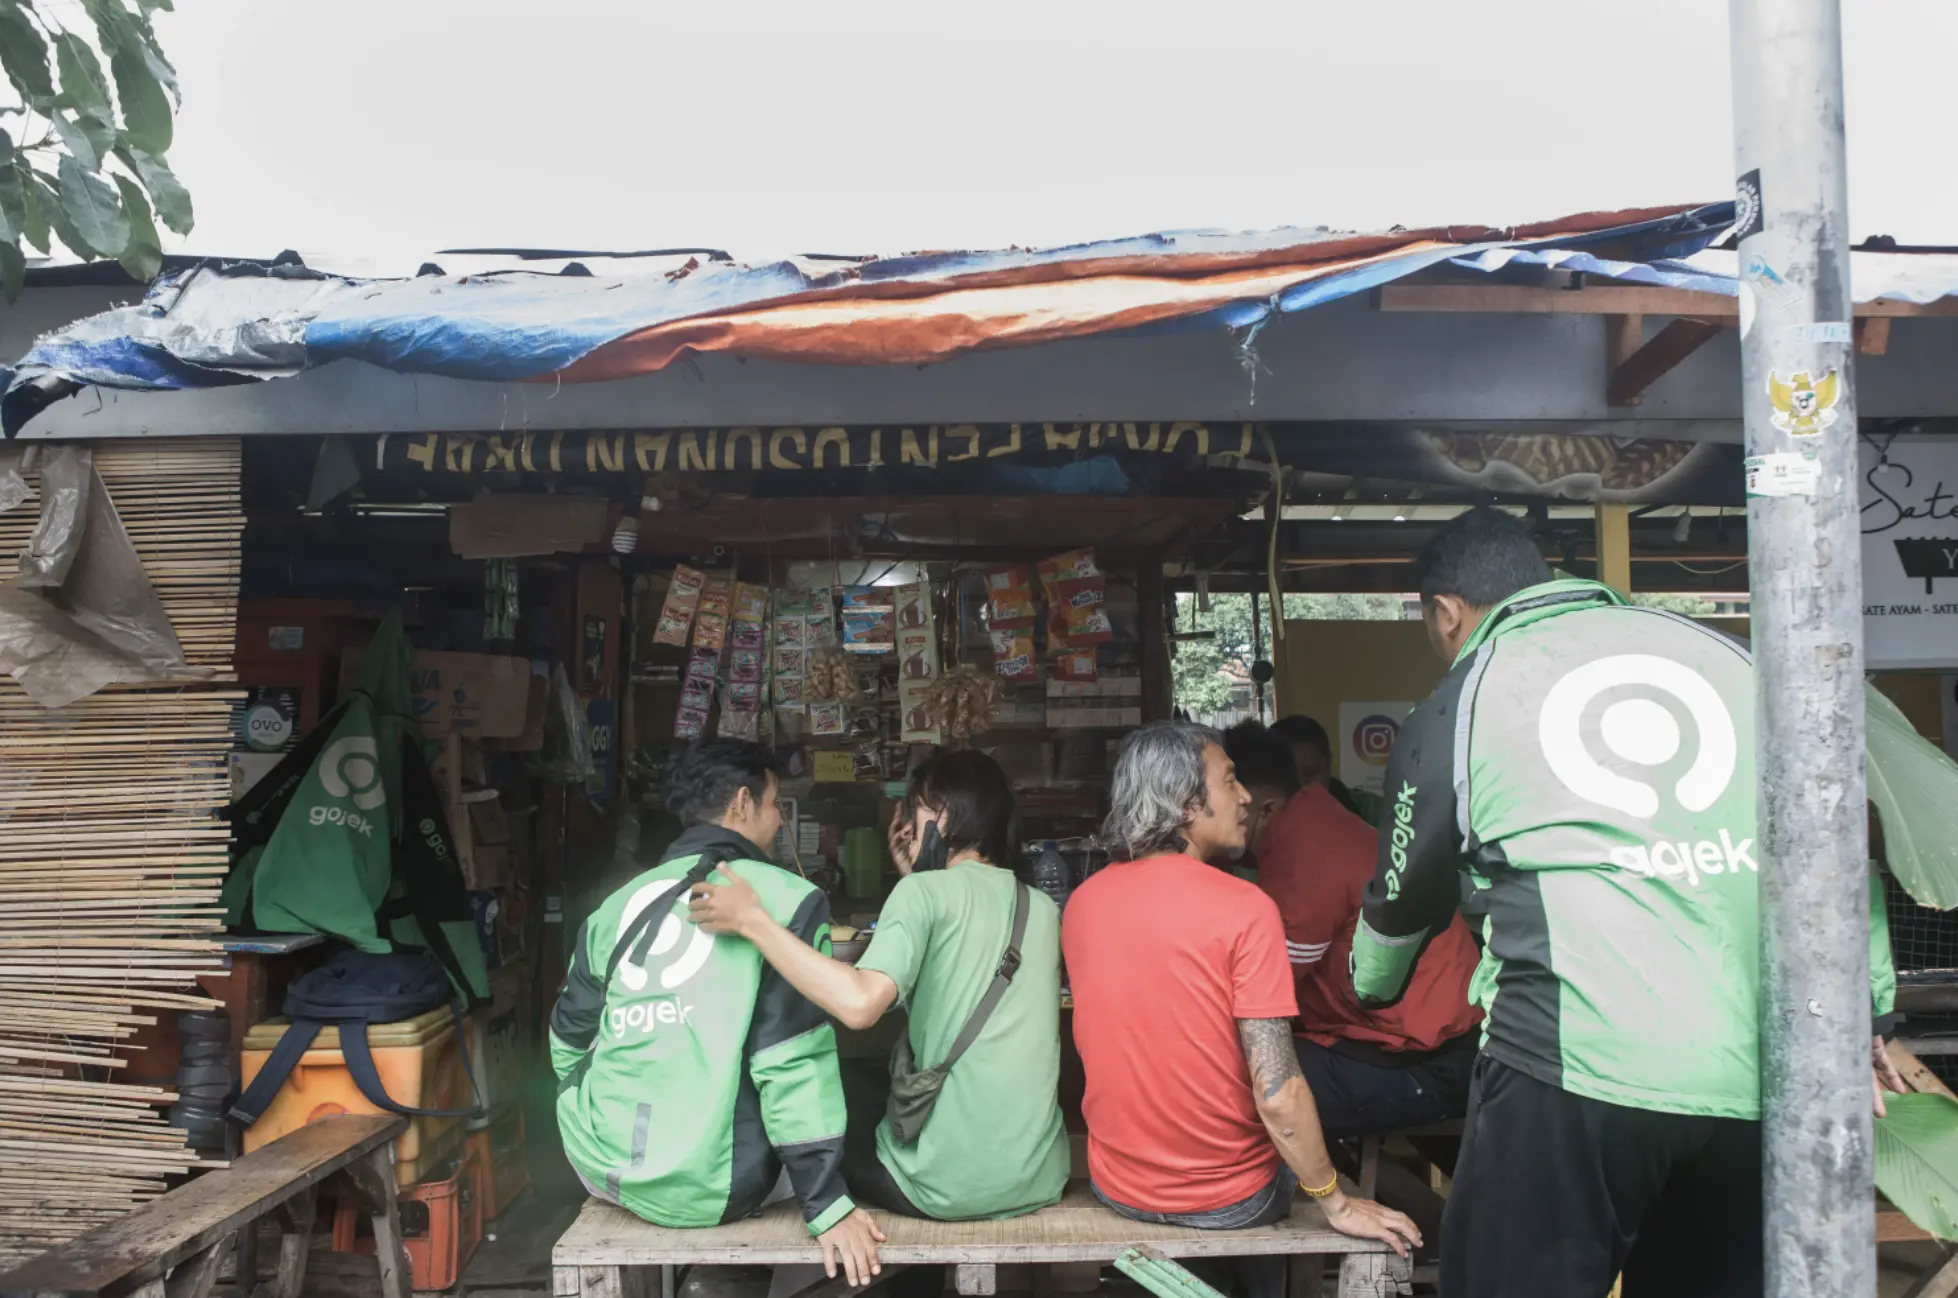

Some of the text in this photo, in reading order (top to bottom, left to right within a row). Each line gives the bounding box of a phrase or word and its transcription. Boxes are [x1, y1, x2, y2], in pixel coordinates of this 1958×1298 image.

[1888, 603, 1922, 616] AYAM
[1932, 602, 1958, 615] SATE
[308, 805, 375, 838] gojek
[1390, 779, 1418, 874] gojek
[610, 996, 695, 1039] gojek
